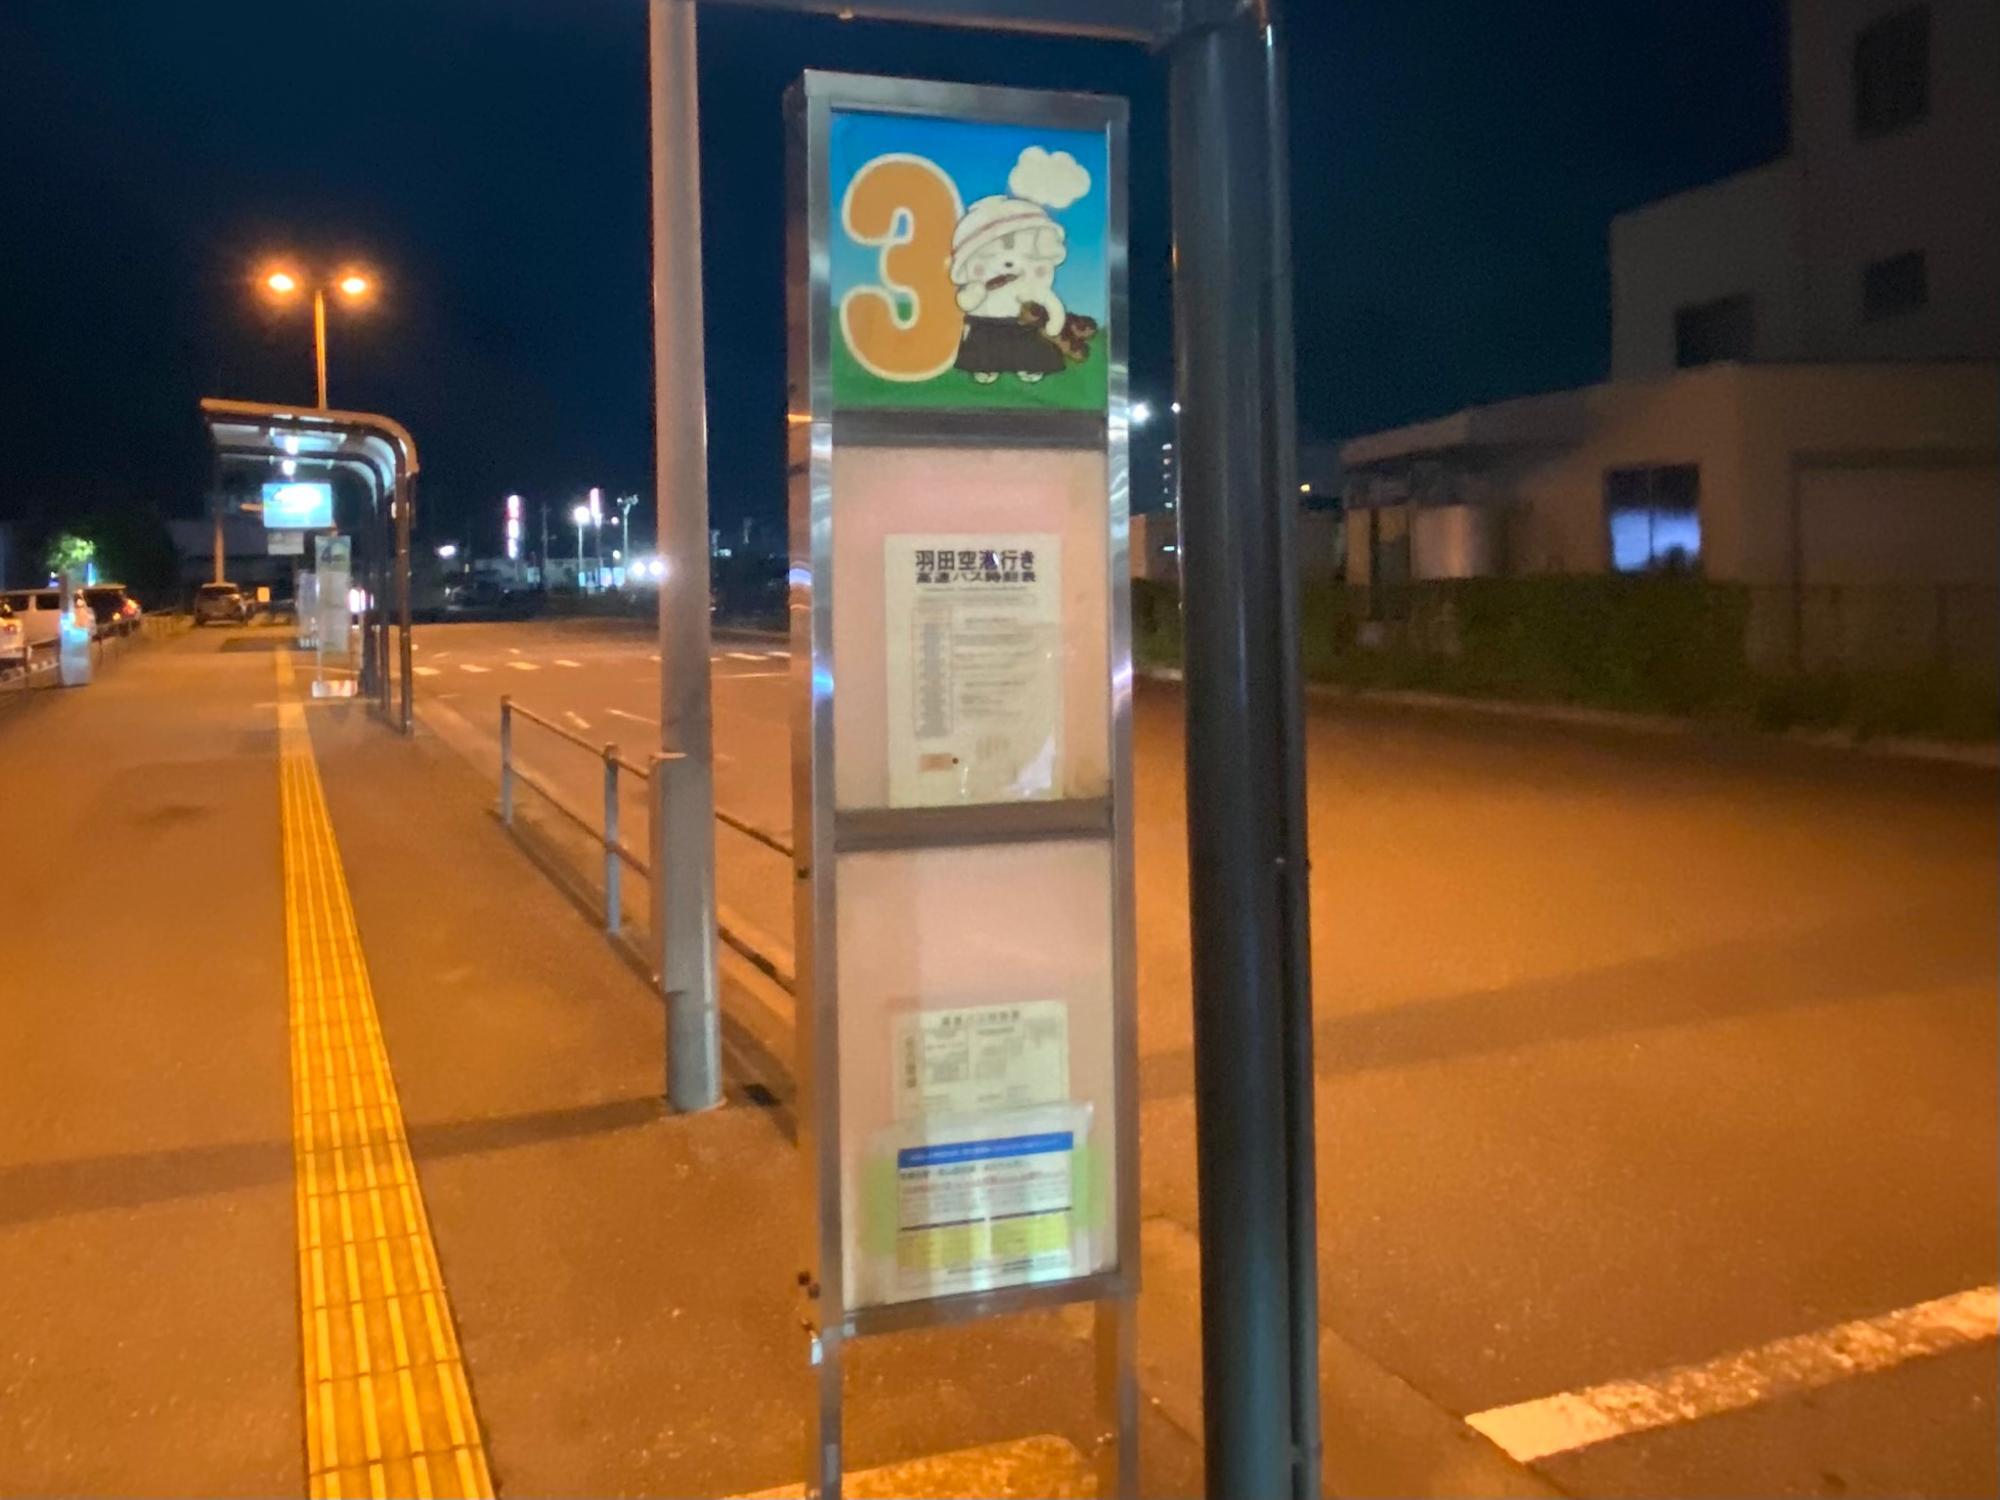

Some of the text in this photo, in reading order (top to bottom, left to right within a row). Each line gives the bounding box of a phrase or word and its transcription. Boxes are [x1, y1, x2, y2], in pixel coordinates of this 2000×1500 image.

[840, 152, 966, 382] 3
[915, 550, 1035, 572] 羽田空港行き
